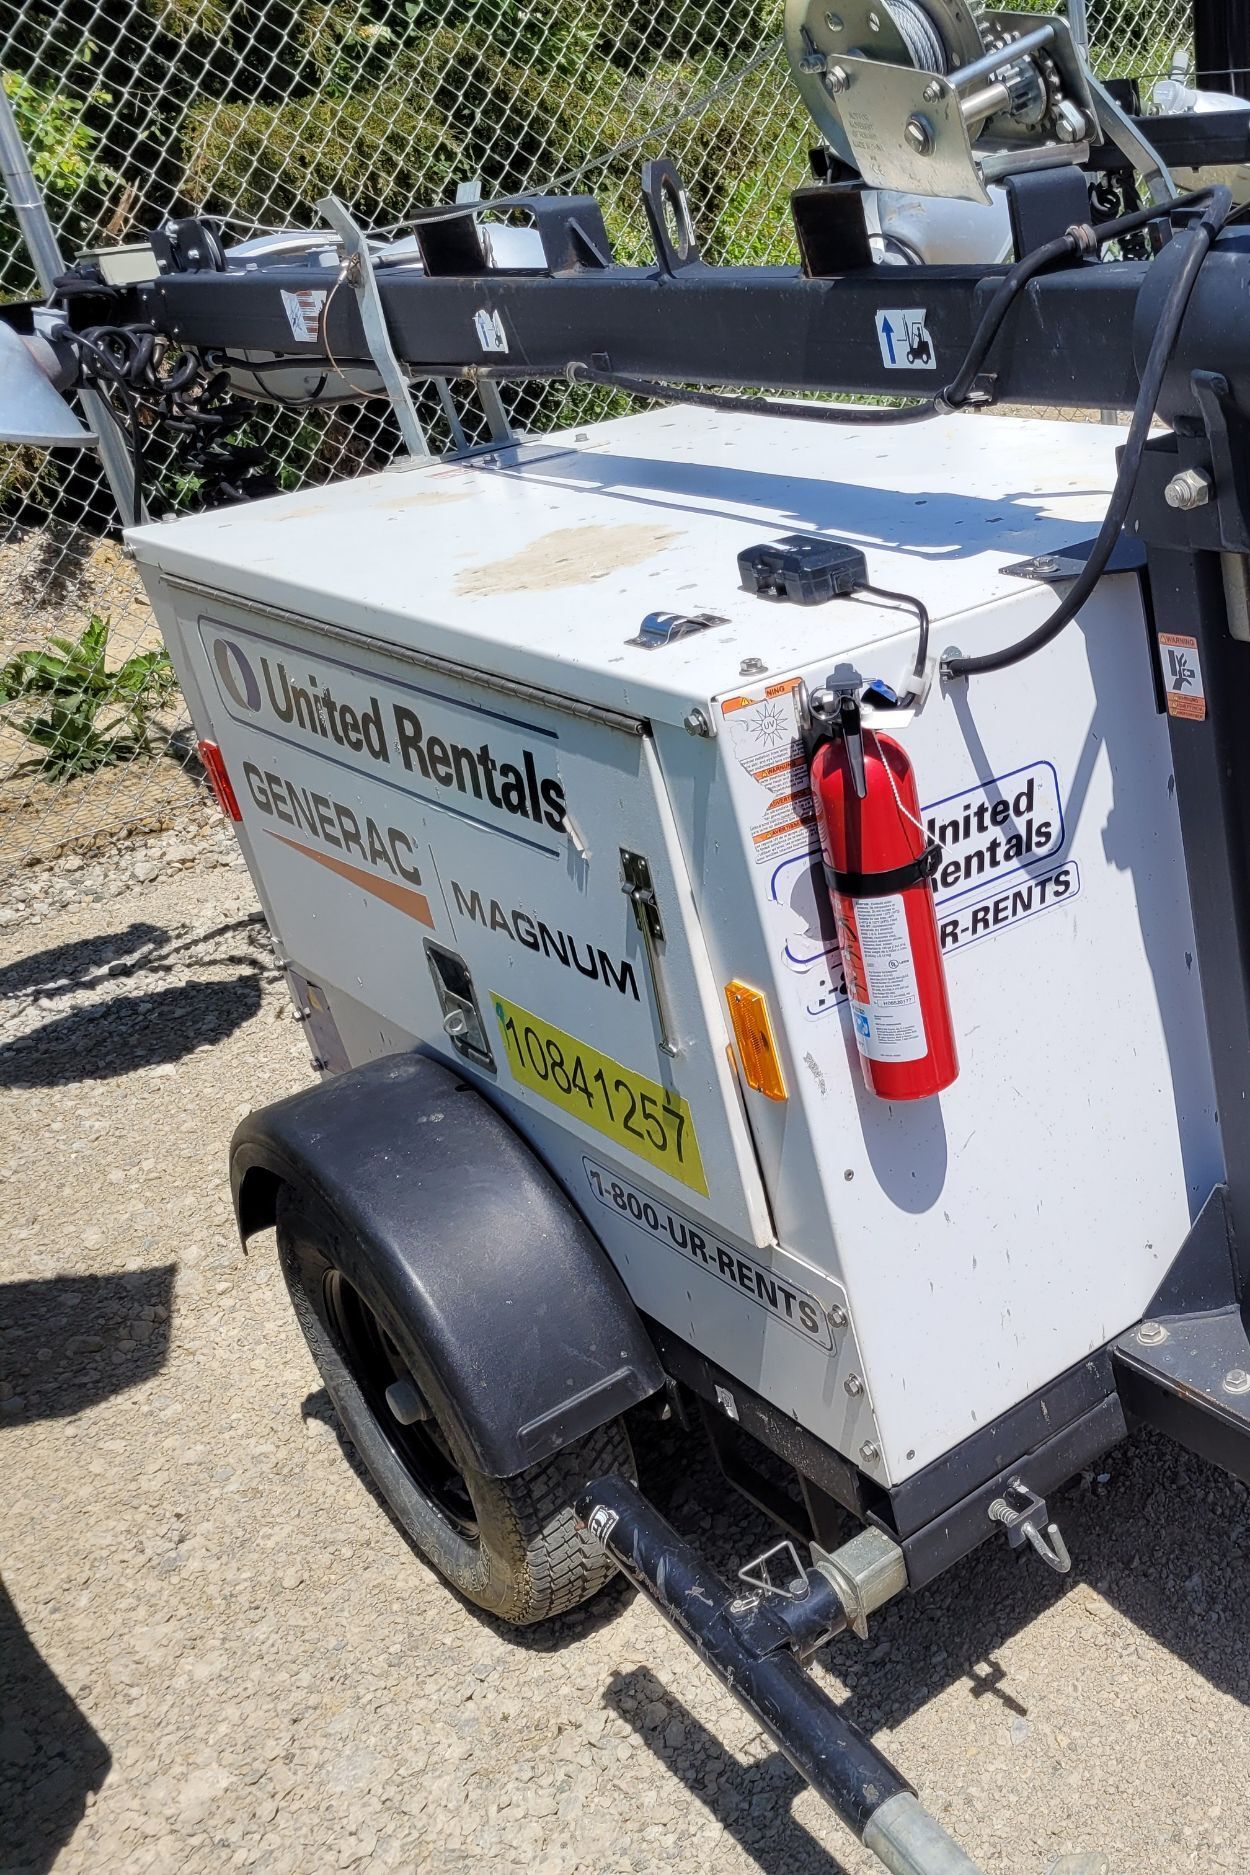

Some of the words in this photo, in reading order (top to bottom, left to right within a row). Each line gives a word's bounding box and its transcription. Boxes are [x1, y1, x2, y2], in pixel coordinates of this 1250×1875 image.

[260, 657, 390, 763] United
[393, 703, 567, 833] Rentals
[763, 720, 775, 730] UV
[243, 761, 422, 886] GENERAC
[930, 818, 1052, 893] entals
[450, 881, 641, 1002] MAGNUM
[505, 1017, 685, 1164] 10841257
[589, 1170, 819, 1334] 1-800-UR-RENTS
